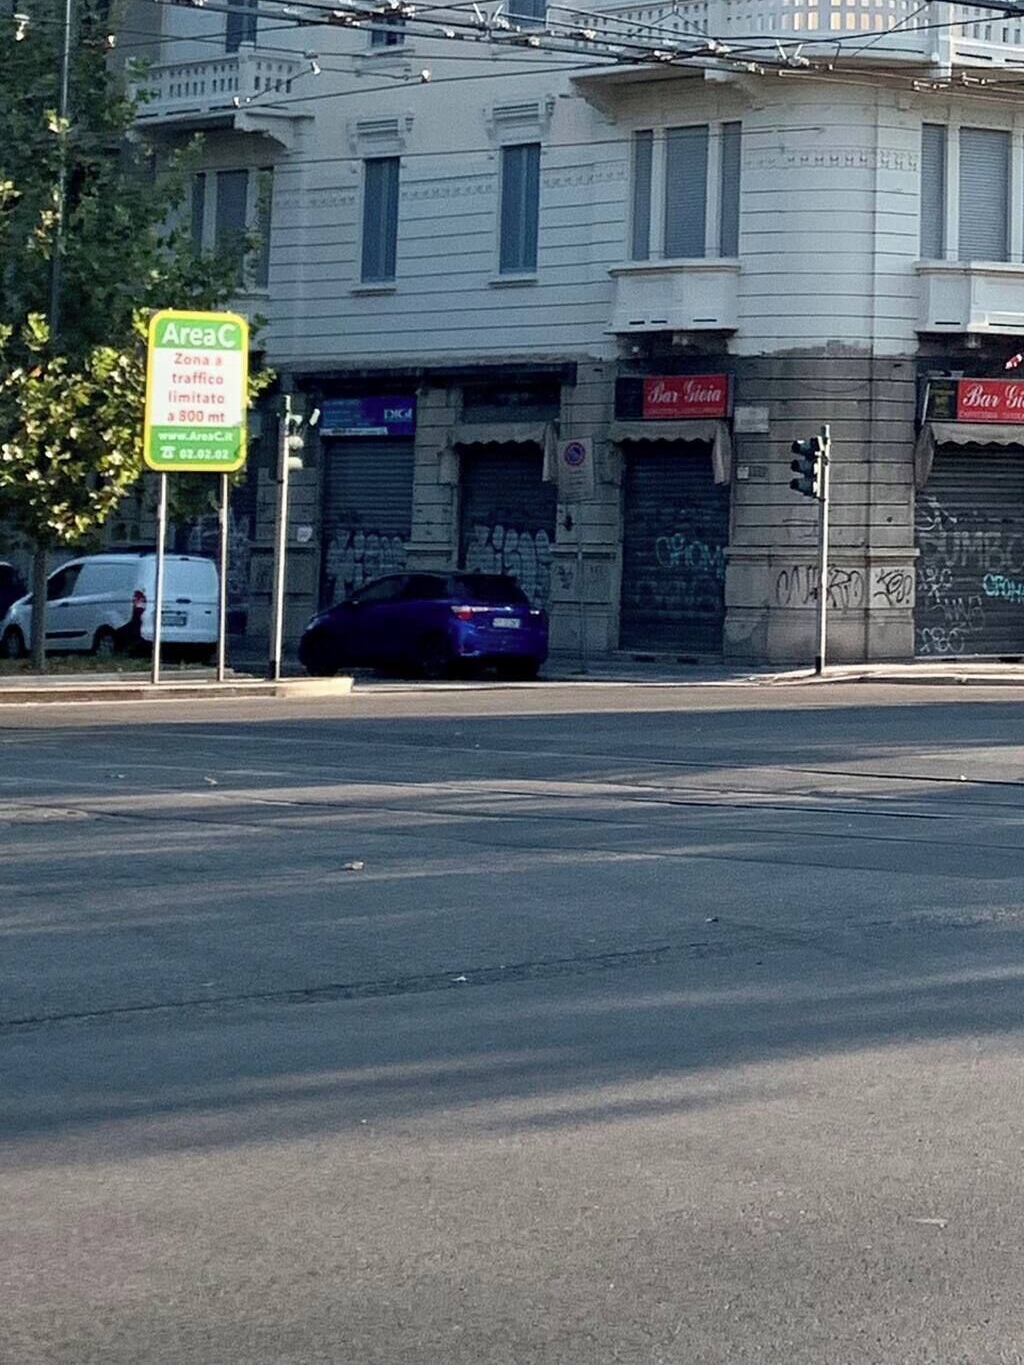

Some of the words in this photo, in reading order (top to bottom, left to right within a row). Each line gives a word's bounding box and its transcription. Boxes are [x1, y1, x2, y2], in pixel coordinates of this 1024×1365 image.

[174, 352, 210, 366] Zona
[215, 356, 223, 367] a
[172, 372, 224, 385] traffico
[168, 391, 225, 404] limitato
[648, 381, 678, 403] Bar
[684, 380, 721, 402] Gioia
[962, 384, 999, 407] Bar
[167, 412, 175, 422] a
[207, 413, 225, 423] mt
